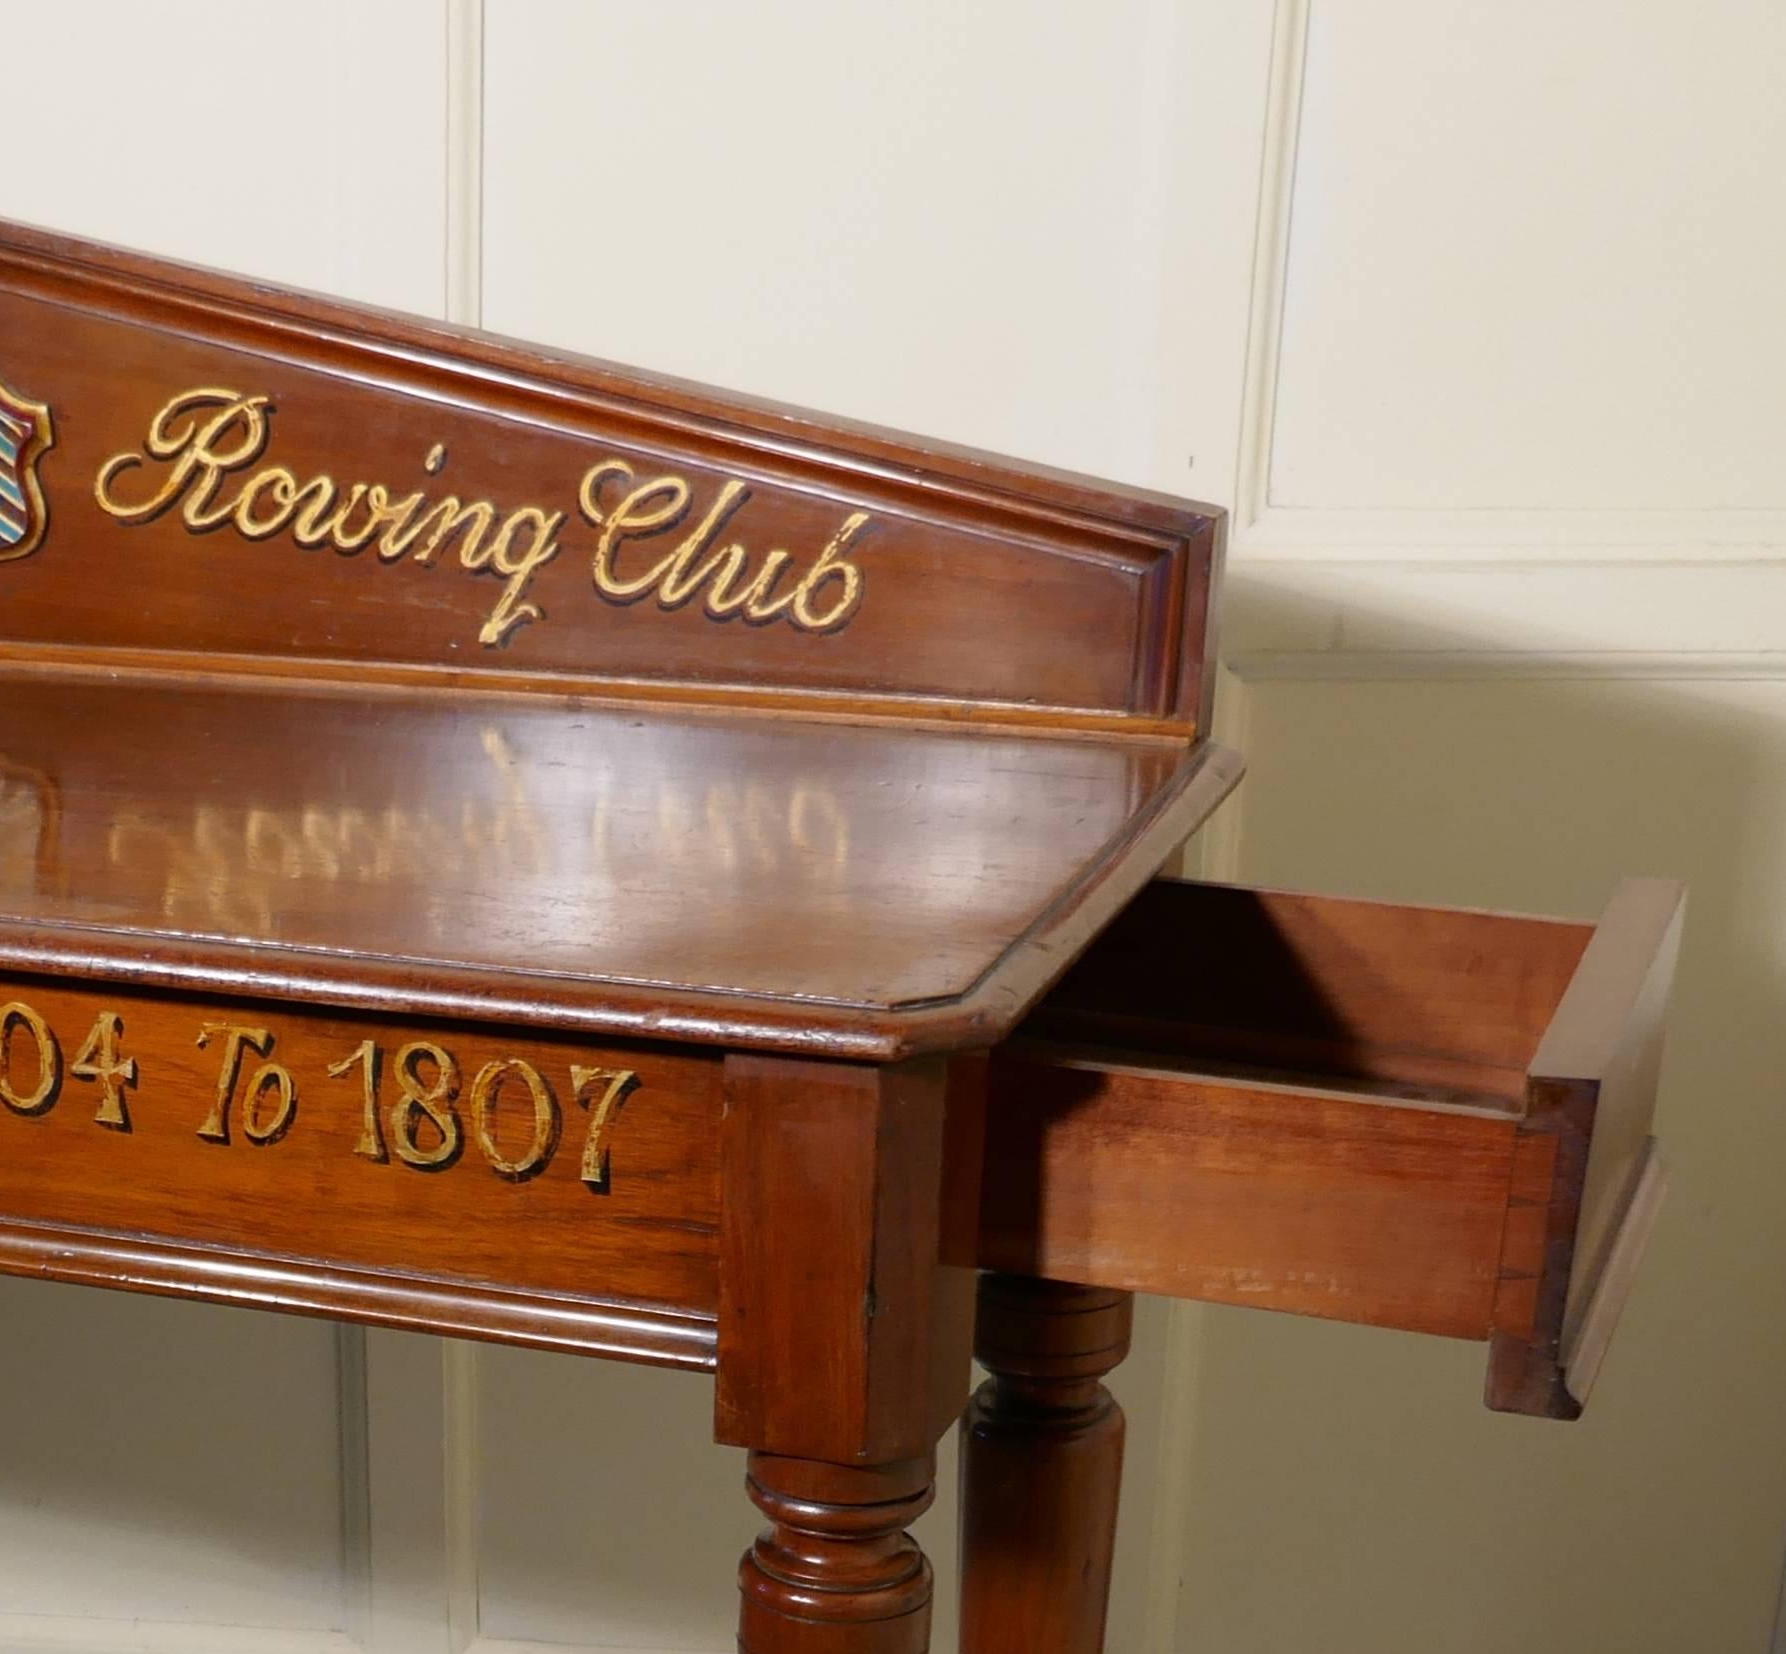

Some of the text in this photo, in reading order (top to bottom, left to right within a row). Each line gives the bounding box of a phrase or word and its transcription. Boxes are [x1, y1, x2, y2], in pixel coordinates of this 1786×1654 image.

[94, 387, 559, 646] Rowing
[578, 459, 870, 628] Club
[195, 1020, 297, 1143] To
[327, 1038, 638, 1185] 1807
